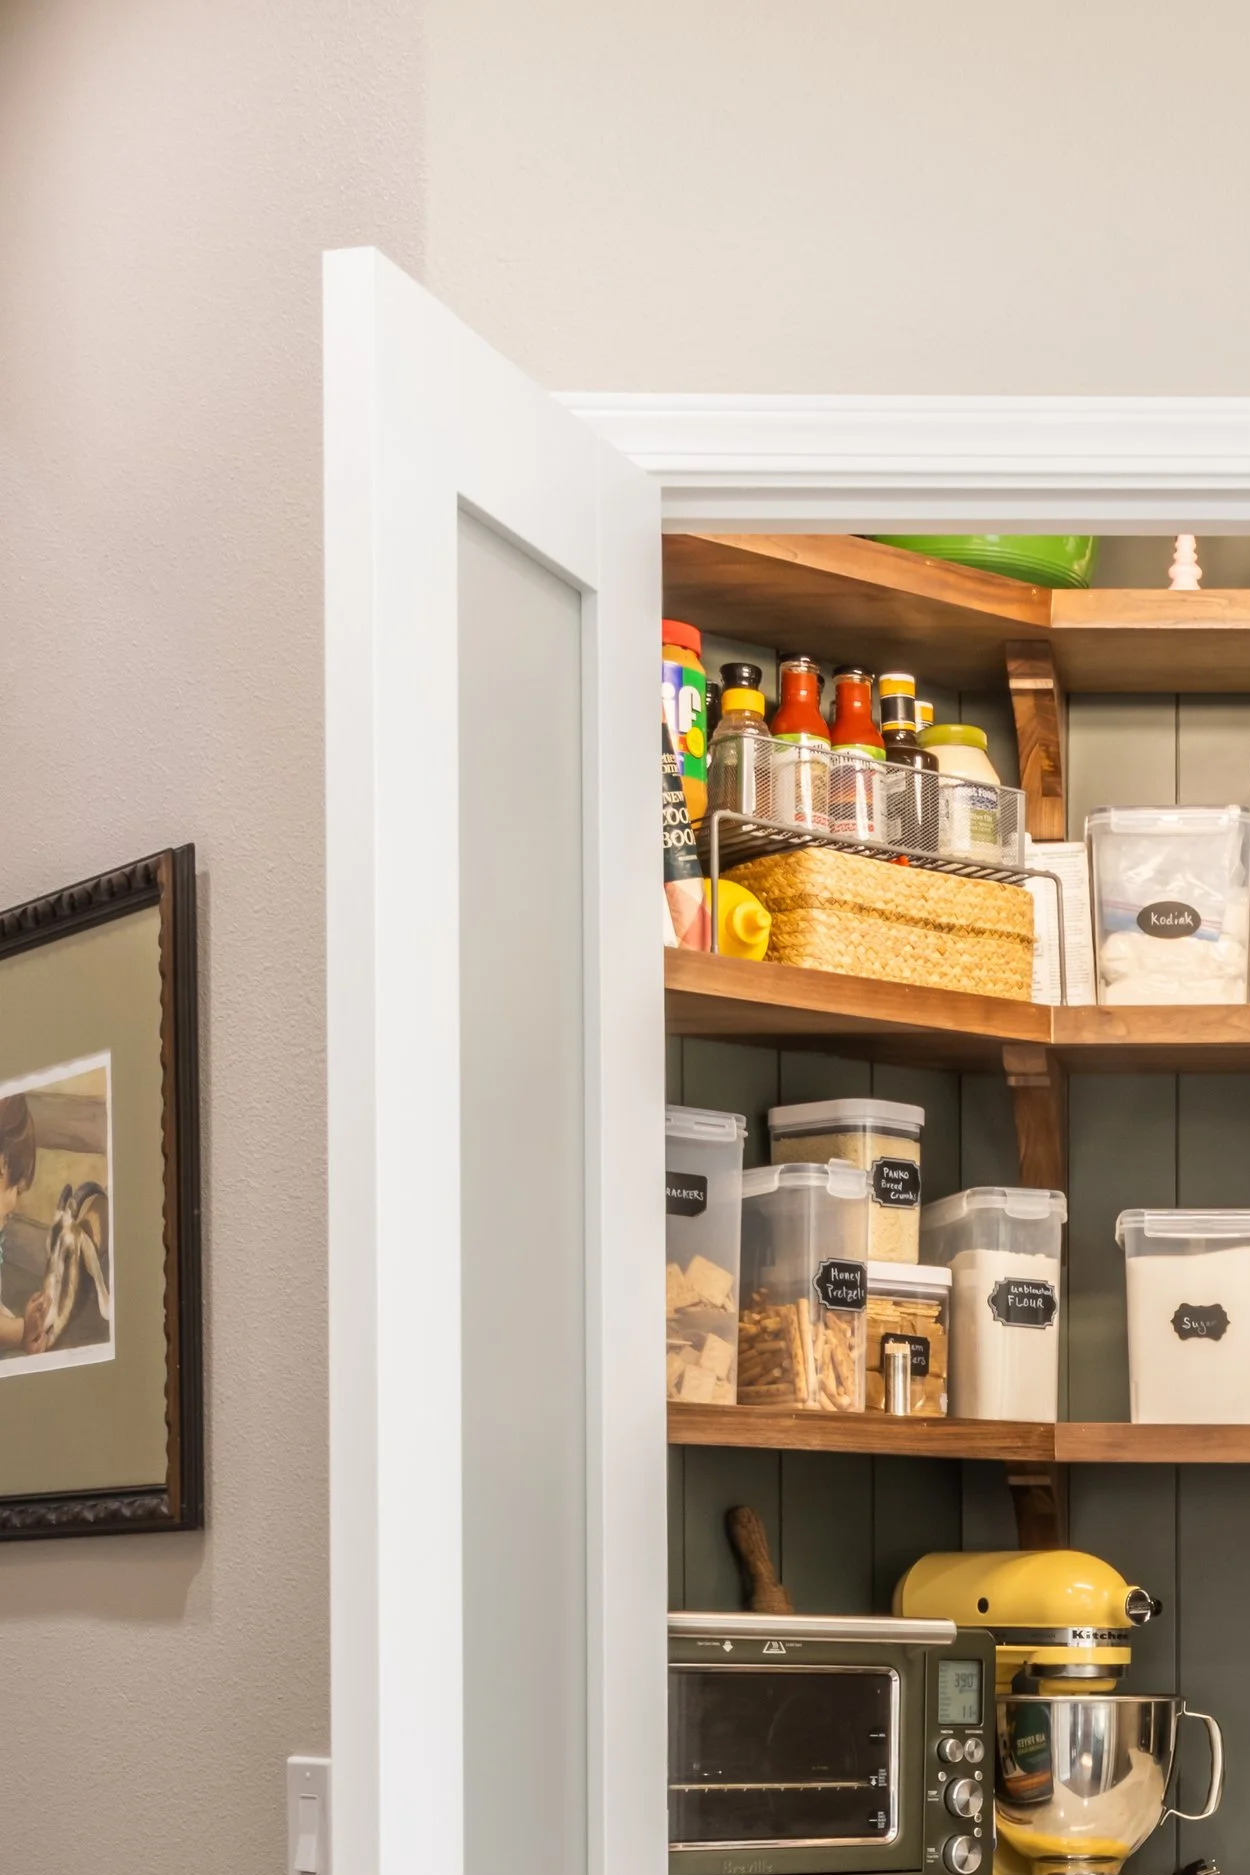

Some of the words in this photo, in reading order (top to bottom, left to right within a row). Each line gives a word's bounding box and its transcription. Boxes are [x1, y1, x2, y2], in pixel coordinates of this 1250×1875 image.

[662, 682, 702, 735] if
[663, 807, 691, 826] COO
[663, 828, 697, 848] BOO
[1150, 911, 1194, 926] Kodiak
[666, 1187, 705, 1201] RACKERS
[881, 1179, 903, 1191] Bread
[831, 1267, 861, 1288] Honey
